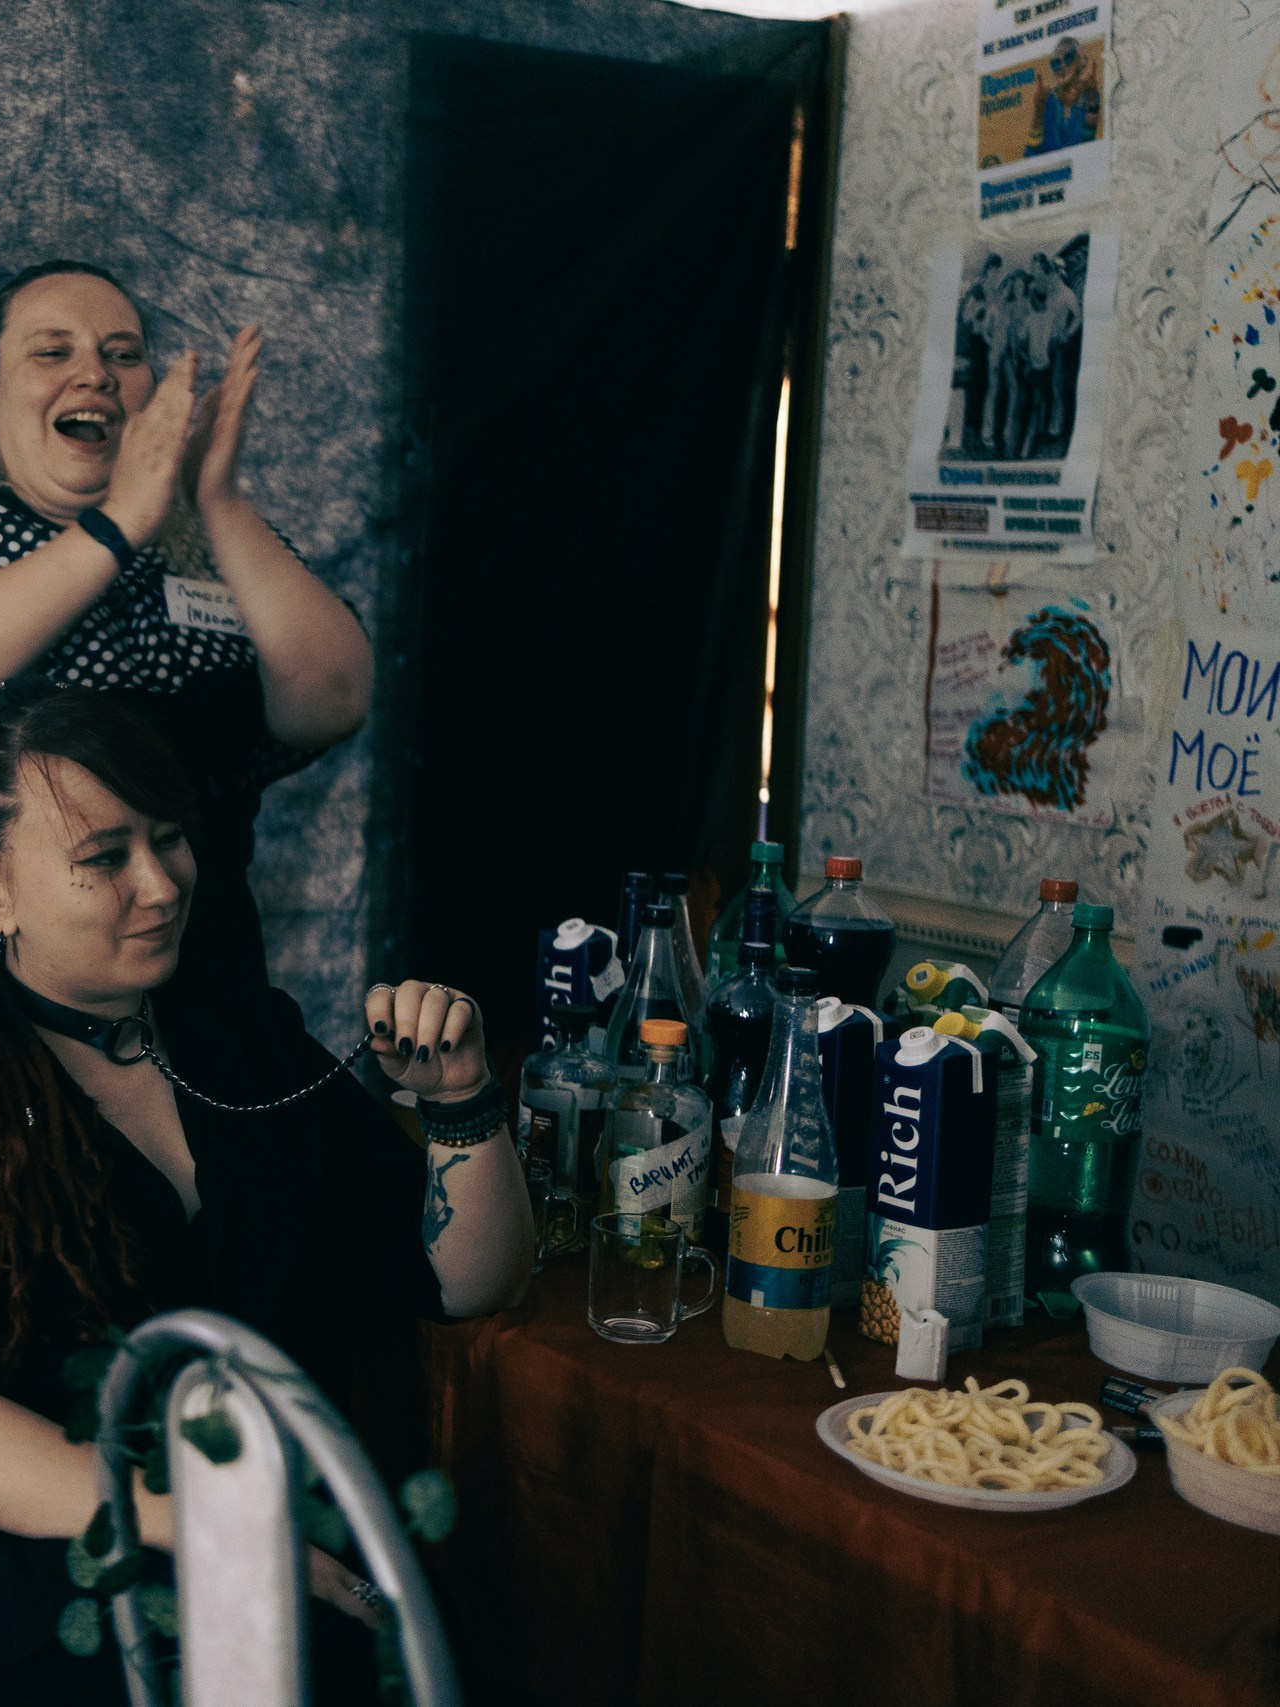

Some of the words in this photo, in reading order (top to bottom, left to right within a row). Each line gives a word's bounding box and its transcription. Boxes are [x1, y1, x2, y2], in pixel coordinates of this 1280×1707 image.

[1168, 728, 1261, 797] МОЁ
[1084, 1050, 1100, 1061] ES
[877, 1086, 923, 1215] Rich
[629, 1146, 694, 1195] ВАРИАНТ
[775, 1225, 832, 1253] Chill
[803, 1254, 830, 1265] TON
[1139, 1430, 1162, 1438] DURA
